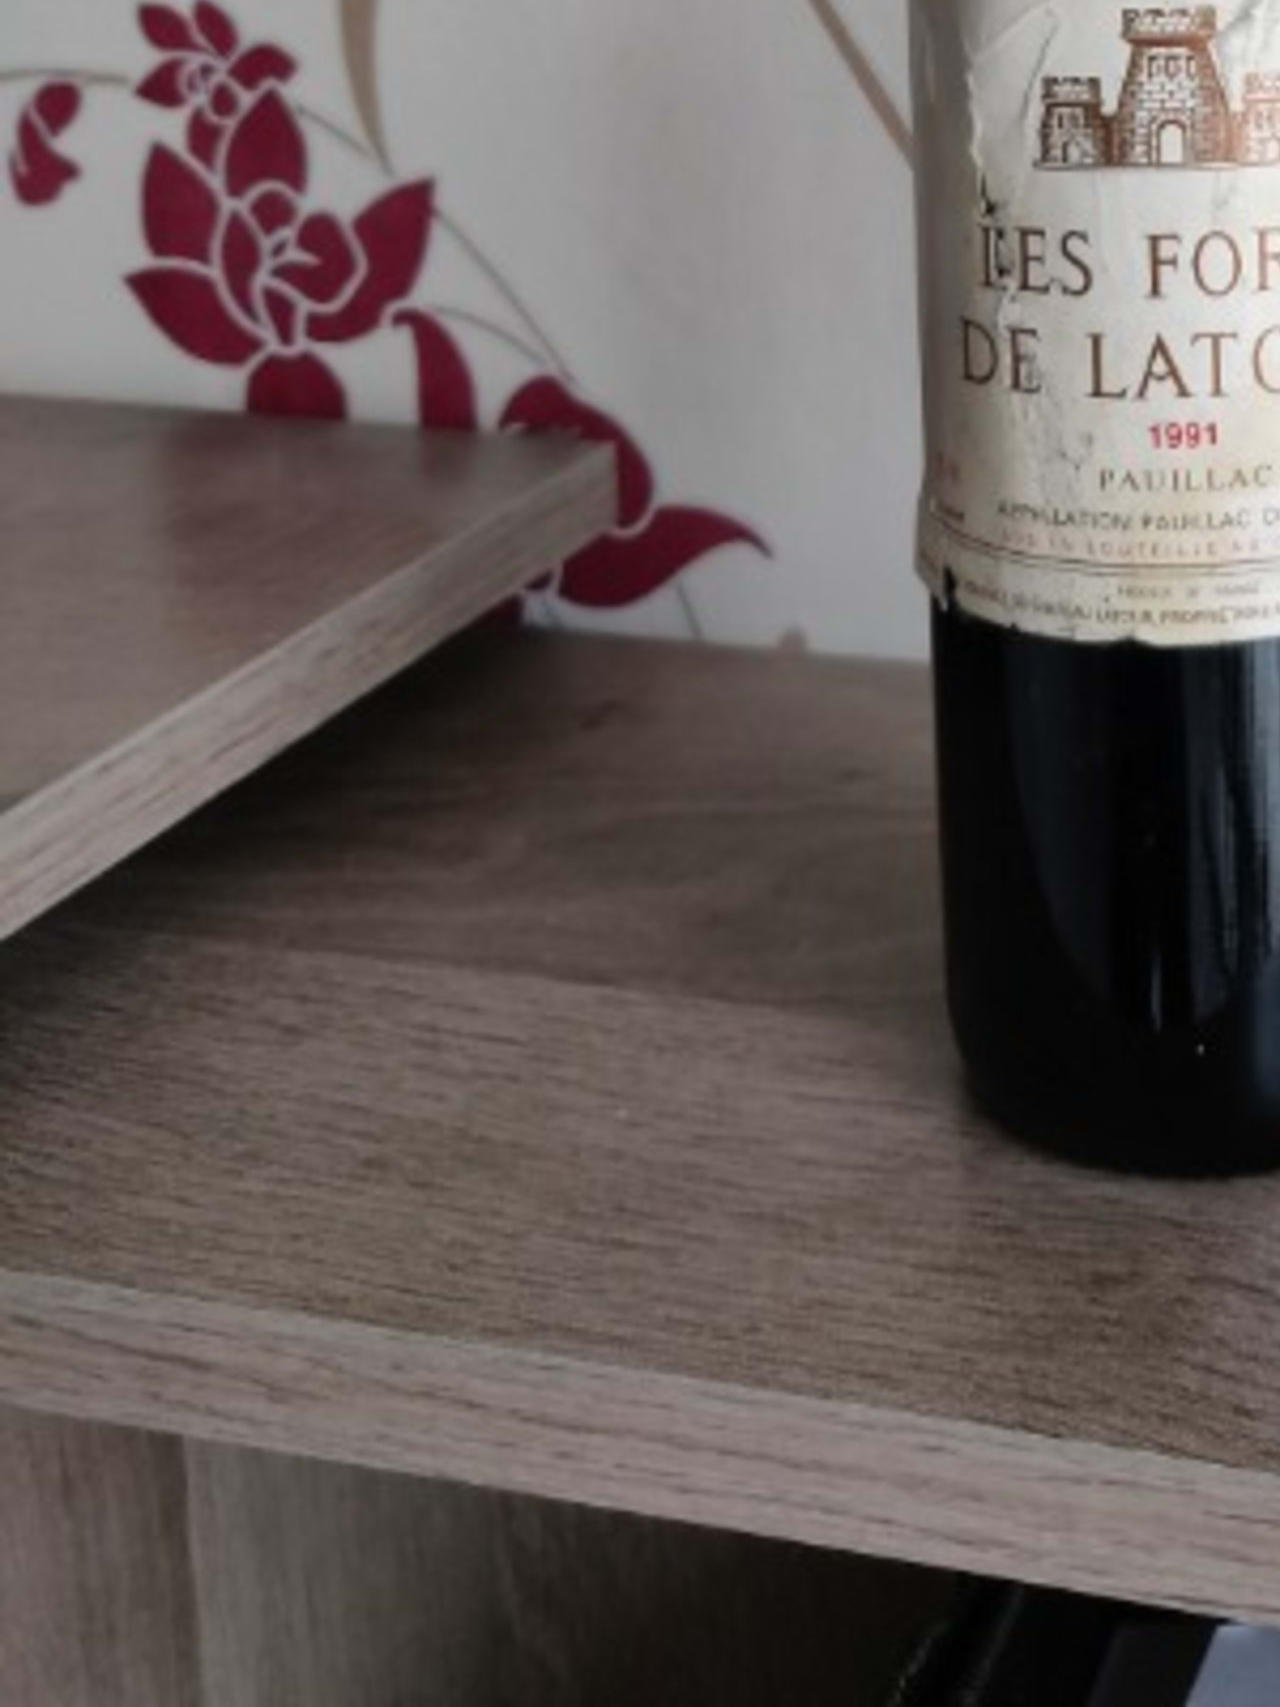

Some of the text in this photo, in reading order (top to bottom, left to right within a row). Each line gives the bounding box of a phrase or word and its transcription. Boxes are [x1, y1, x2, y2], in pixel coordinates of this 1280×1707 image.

[980, 224, 1093, 296] LES
[959, 315, 1043, 394] DE
[1147, 421, 1218, 449] 1991
[1099, 464, 1273, 492] PAUILLAC
